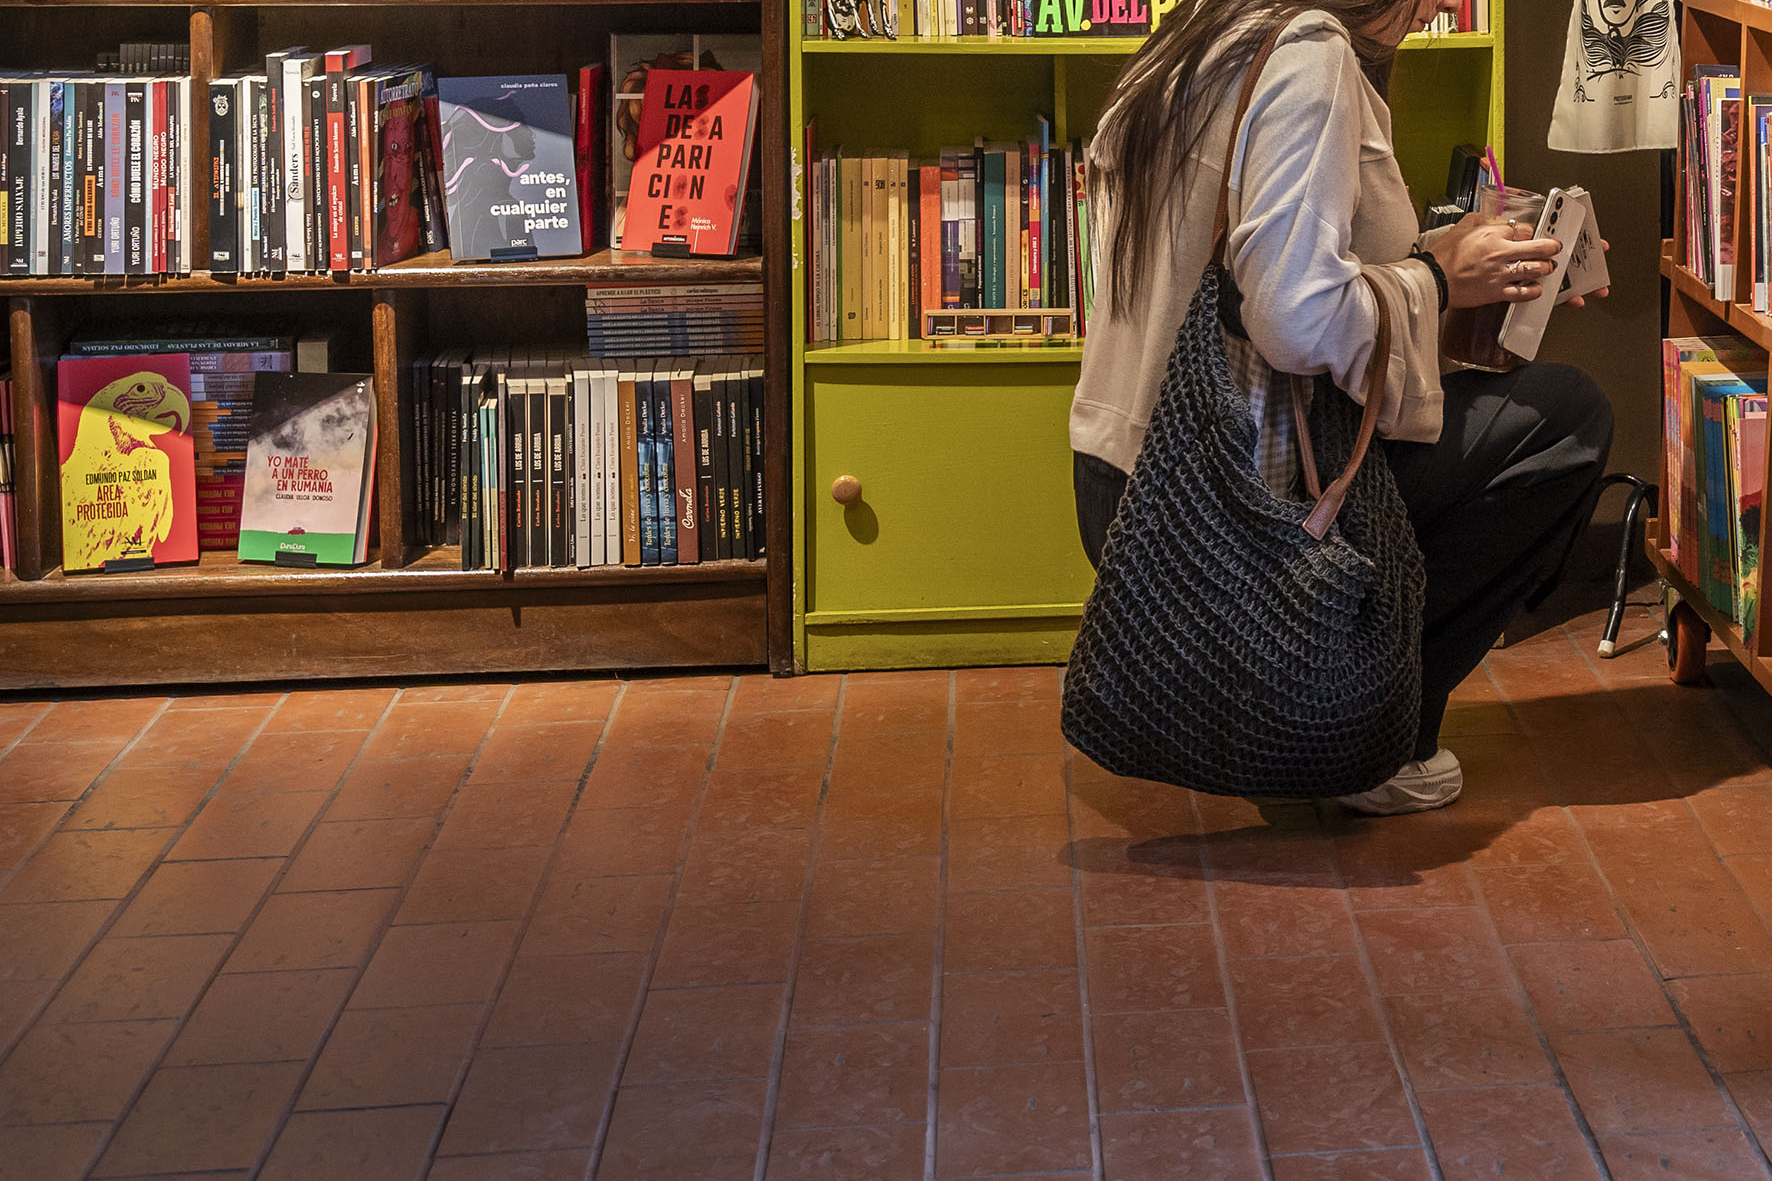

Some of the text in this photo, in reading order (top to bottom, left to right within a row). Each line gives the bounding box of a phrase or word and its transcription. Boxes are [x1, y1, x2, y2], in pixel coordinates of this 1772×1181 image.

[524, 82, 538, 90] peña
[131, 152, 141, 160] EL
[657, 144, 713, 170] PARI
[289, 152, 300, 194] Sanders
[520, 171, 570, 187] antes,
[130, 182, 141, 203] CÓMO
[546, 188, 567, 199] en
[64, 160, 73, 242] AMORES IMPERFECTOS
[490, 201, 567, 217] cualquier
[15, 211, 24, 247] IMPERIO
[524, 217, 569, 233] parte
[130, 226, 140, 251] ORTUÑO
[511, 238, 528, 248] parc
[131, 251, 140, 266] YURI
[267, 454, 309, 468] YO MATÉ
[515, 460, 523, 471] LOS
[85, 472, 117, 485] EDMUNDO
[118, 471, 131, 483] PAZ
[272, 469, 328, 481] A UN PERRO
[277, 478, 333, 494] EN RUMANÍA
[76, 501, 129, 521] PROTEGIDA
[678, 487, 695, 529] Carmela
